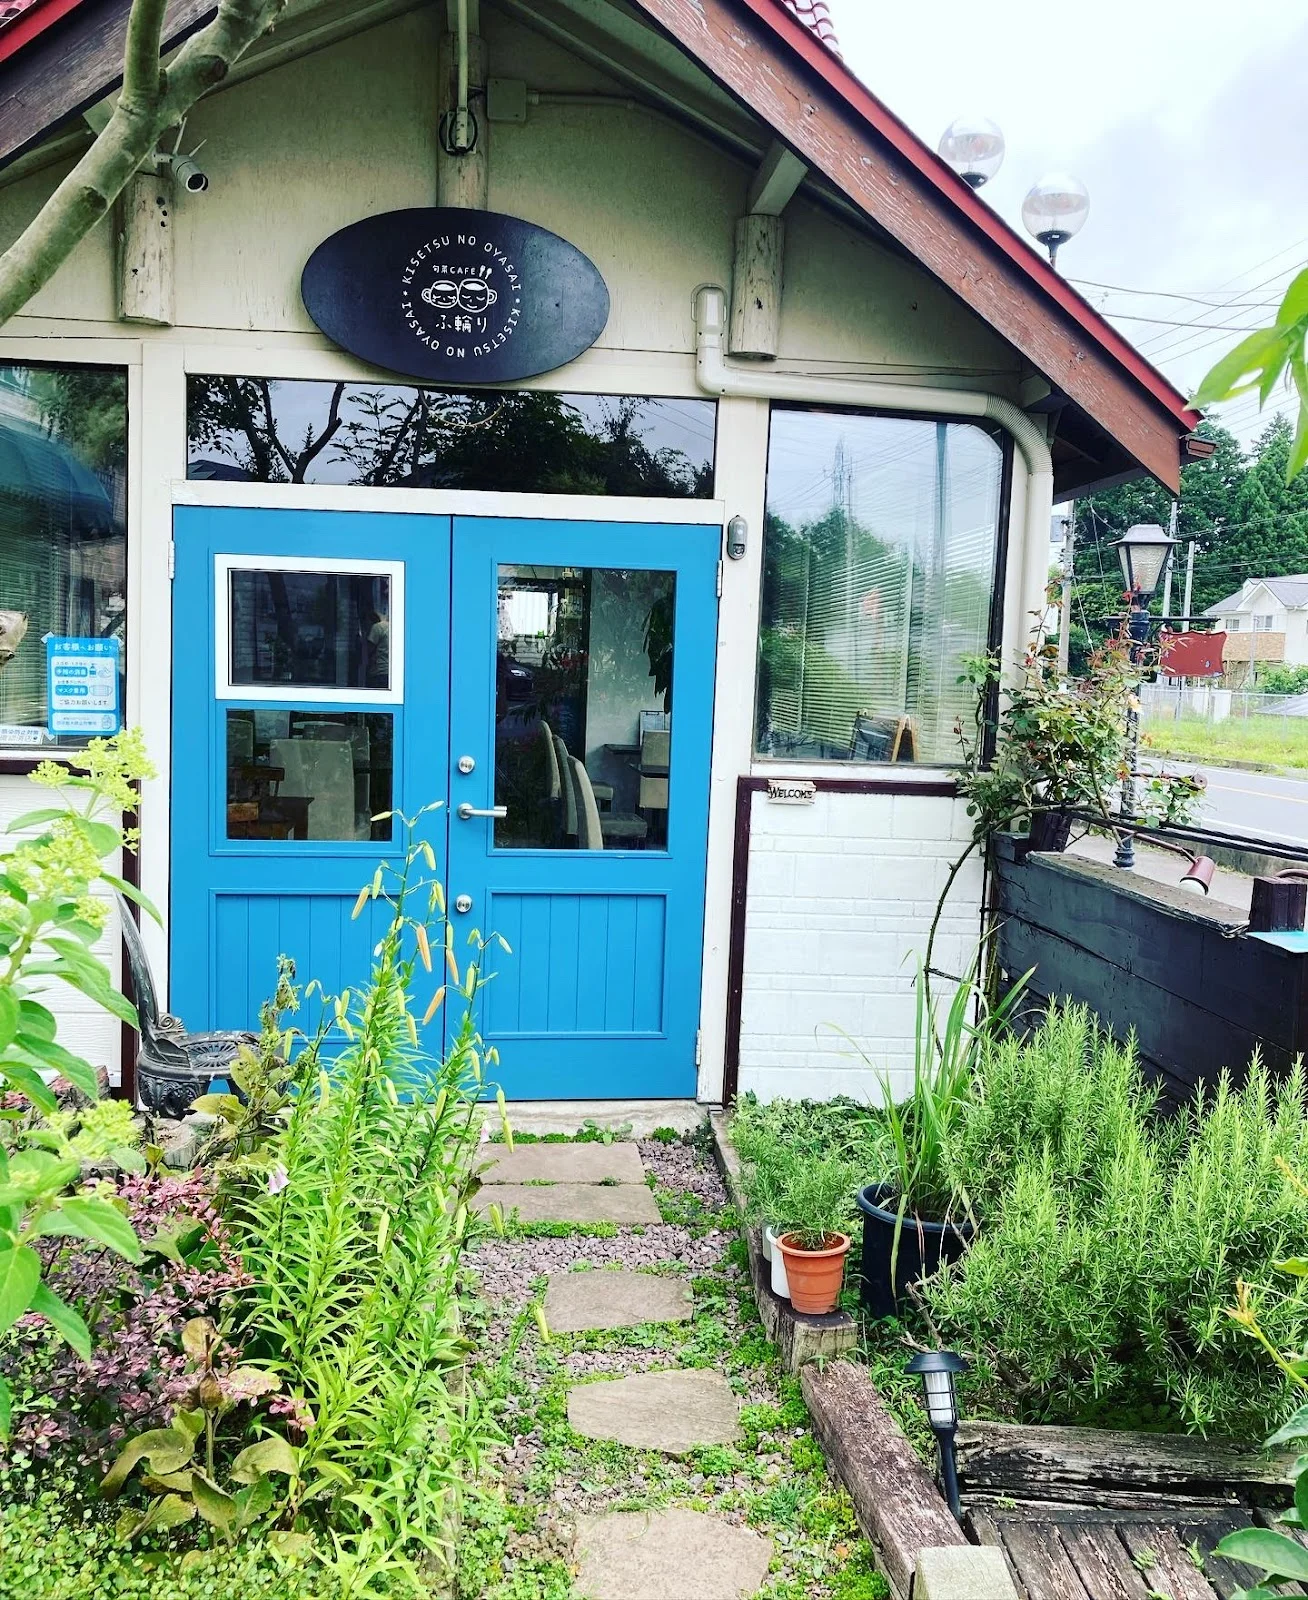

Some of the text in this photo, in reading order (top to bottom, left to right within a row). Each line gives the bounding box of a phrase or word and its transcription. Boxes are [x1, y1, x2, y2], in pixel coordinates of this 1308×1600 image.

[402, 234, 521, 291] KISETSU NO OYASAI
[401, 301, 521, 358] KISETSU NO OYASAI
[435, 314, 487, 333] ふ輪り
[769, 786, 813, 799] WELCOME
